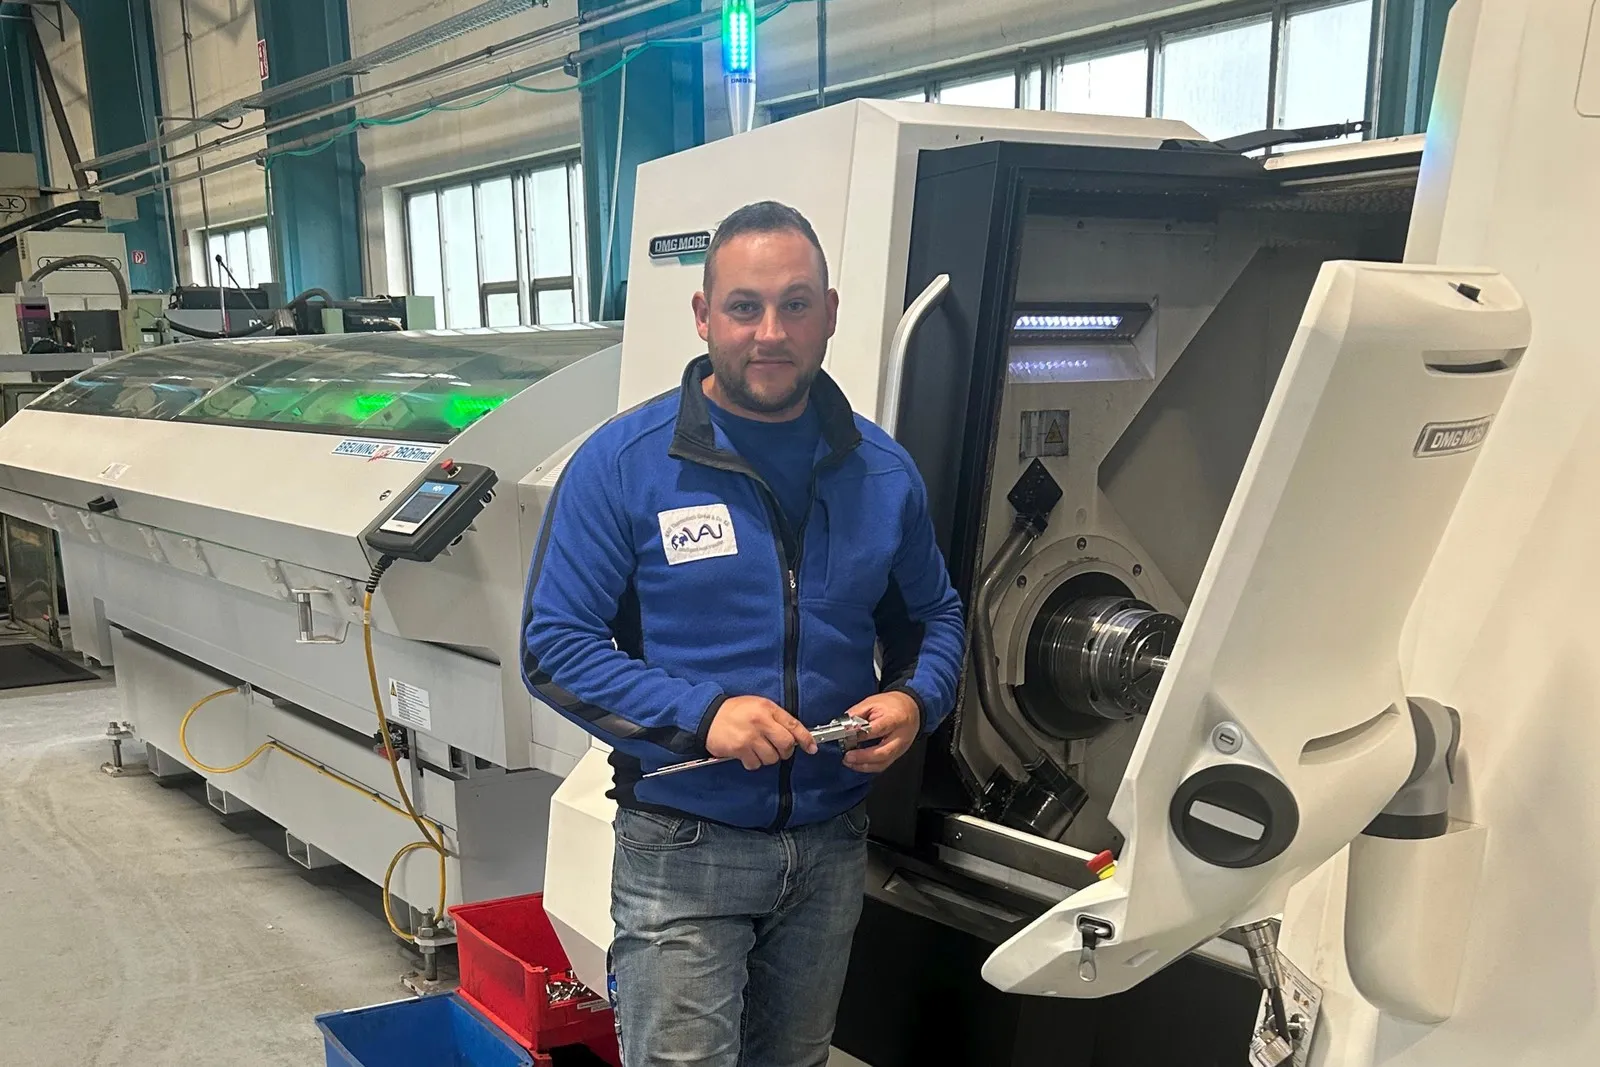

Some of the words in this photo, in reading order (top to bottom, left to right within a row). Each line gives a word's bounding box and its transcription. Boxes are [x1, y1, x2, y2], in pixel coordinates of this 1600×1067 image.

[654, 239, 678, 252] DMG
[678, 235, 709, 250] MORI
[1430, 431, 1462, 449] DMG
[335, 441, 379, 455] BREUNING
[392, 446, 437, 461] PROFImat
